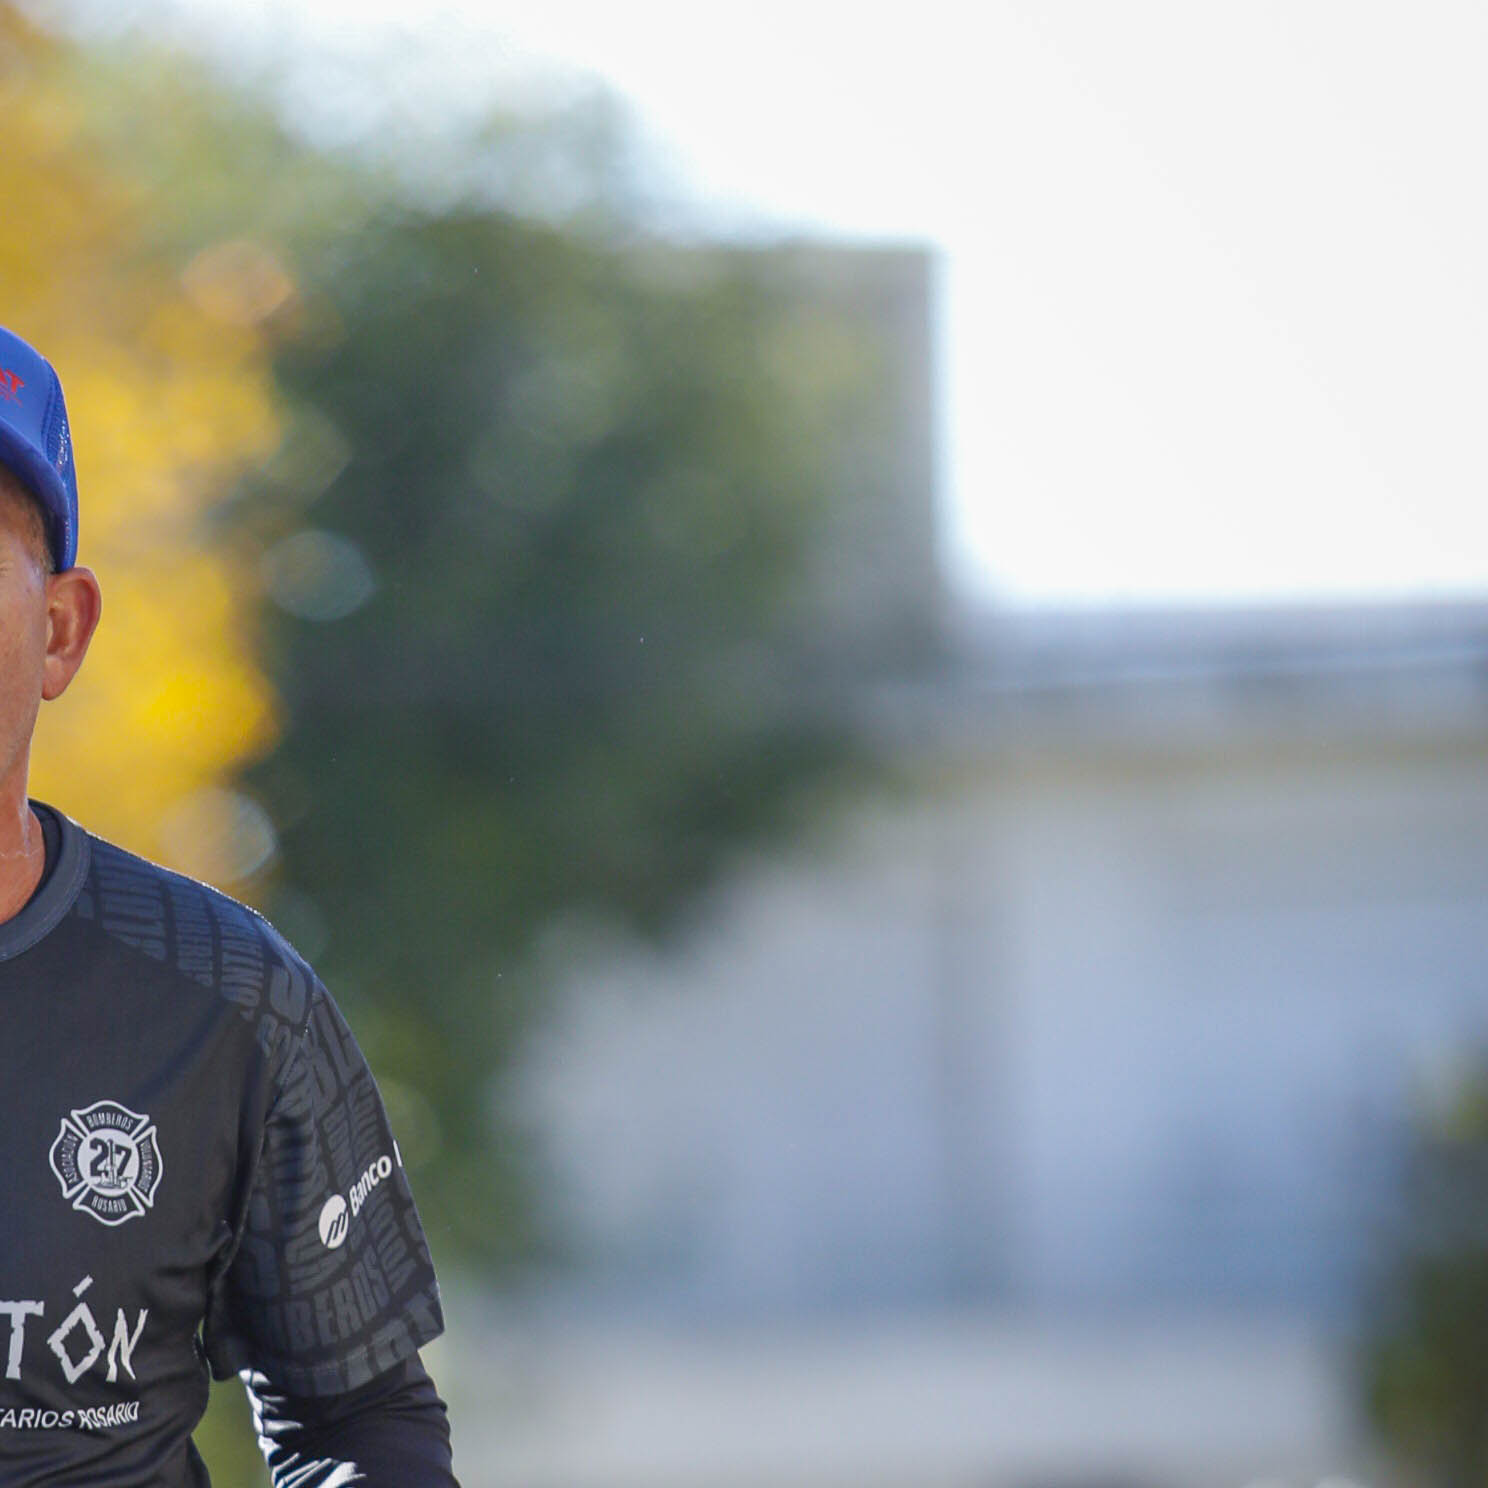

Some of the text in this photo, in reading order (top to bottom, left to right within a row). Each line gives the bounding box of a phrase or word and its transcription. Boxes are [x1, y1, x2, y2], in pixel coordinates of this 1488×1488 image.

[86, 1112, 134, 1131] BOMBEROS
[89, 1137, 132, 1177] 27
[349, 1155, 393, 1217] Banco
[92, 1195, 128, 1213] ROSARIO
[77, 1400, 141, 1430] ROSARIO
